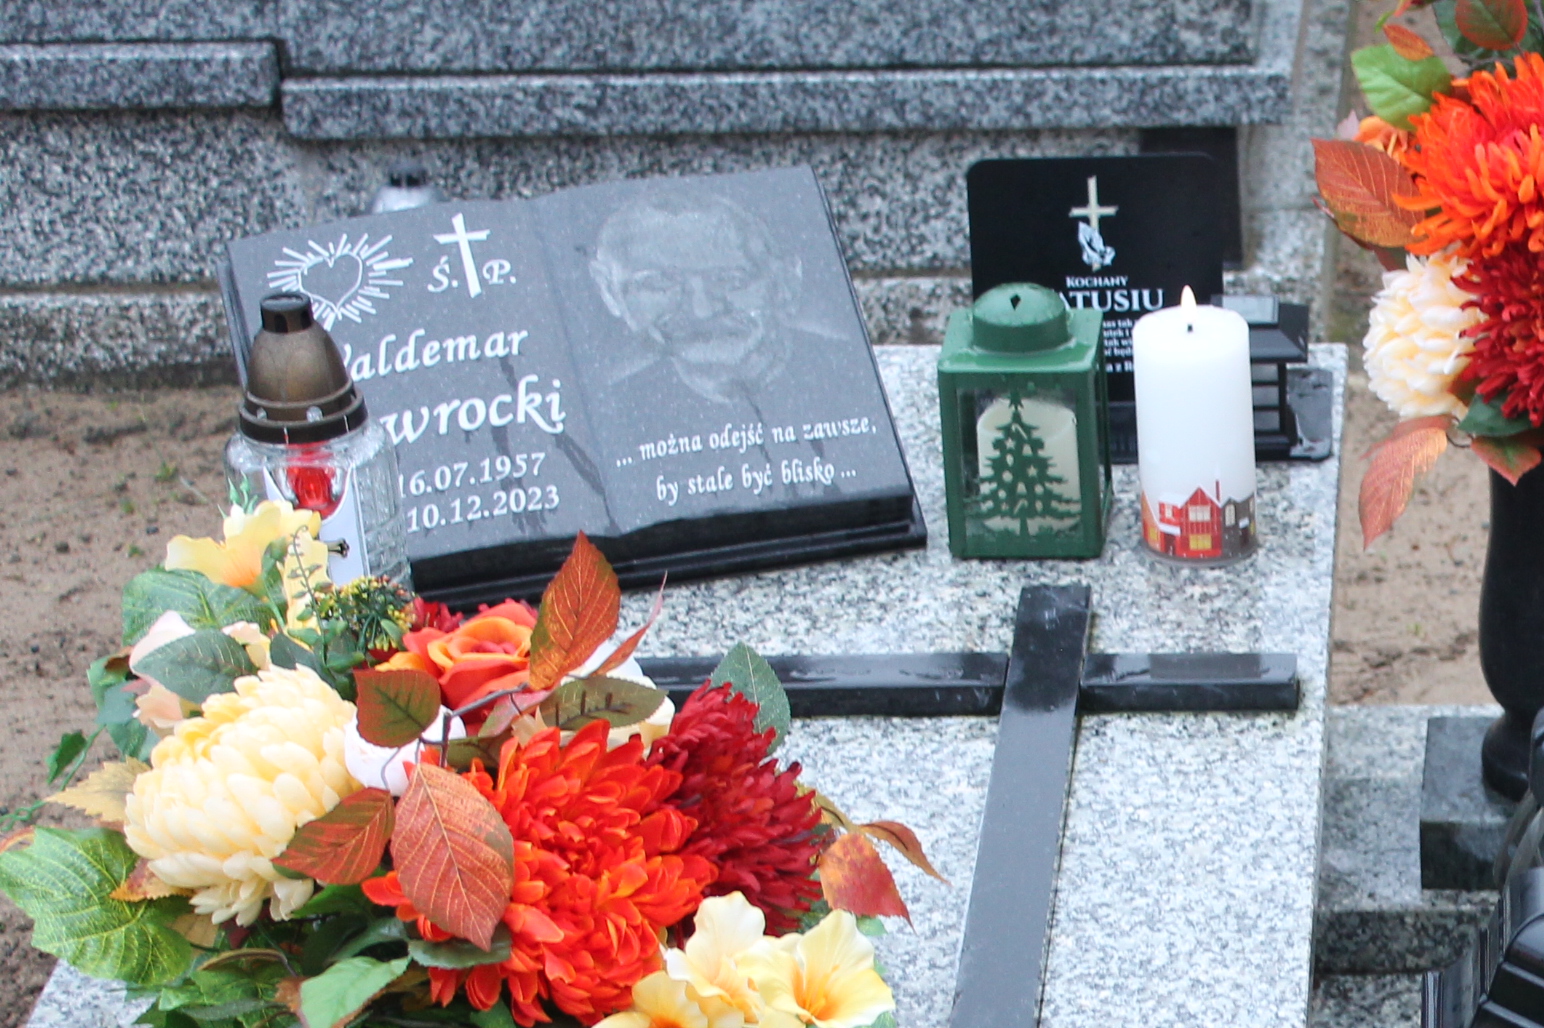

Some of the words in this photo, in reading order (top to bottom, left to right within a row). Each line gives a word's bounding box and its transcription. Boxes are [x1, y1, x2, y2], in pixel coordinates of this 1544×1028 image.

[344, 328, 529, 383] aldemar
[380, 373, 567, 446] wrocki
[639, 432, 703, 461] można
[709, 422, 764, 453] odejść
[771, 426, 797, 444] na
[398, 451, 547, 499] 16.07.1957
[655, 475, 680, 507] by
[687, 465, 734, 496] stale
[741, 462, 774, 494] być
[781, 456, 836, 485] blisko
[406, 483, 560, 534] 10.12.2023
